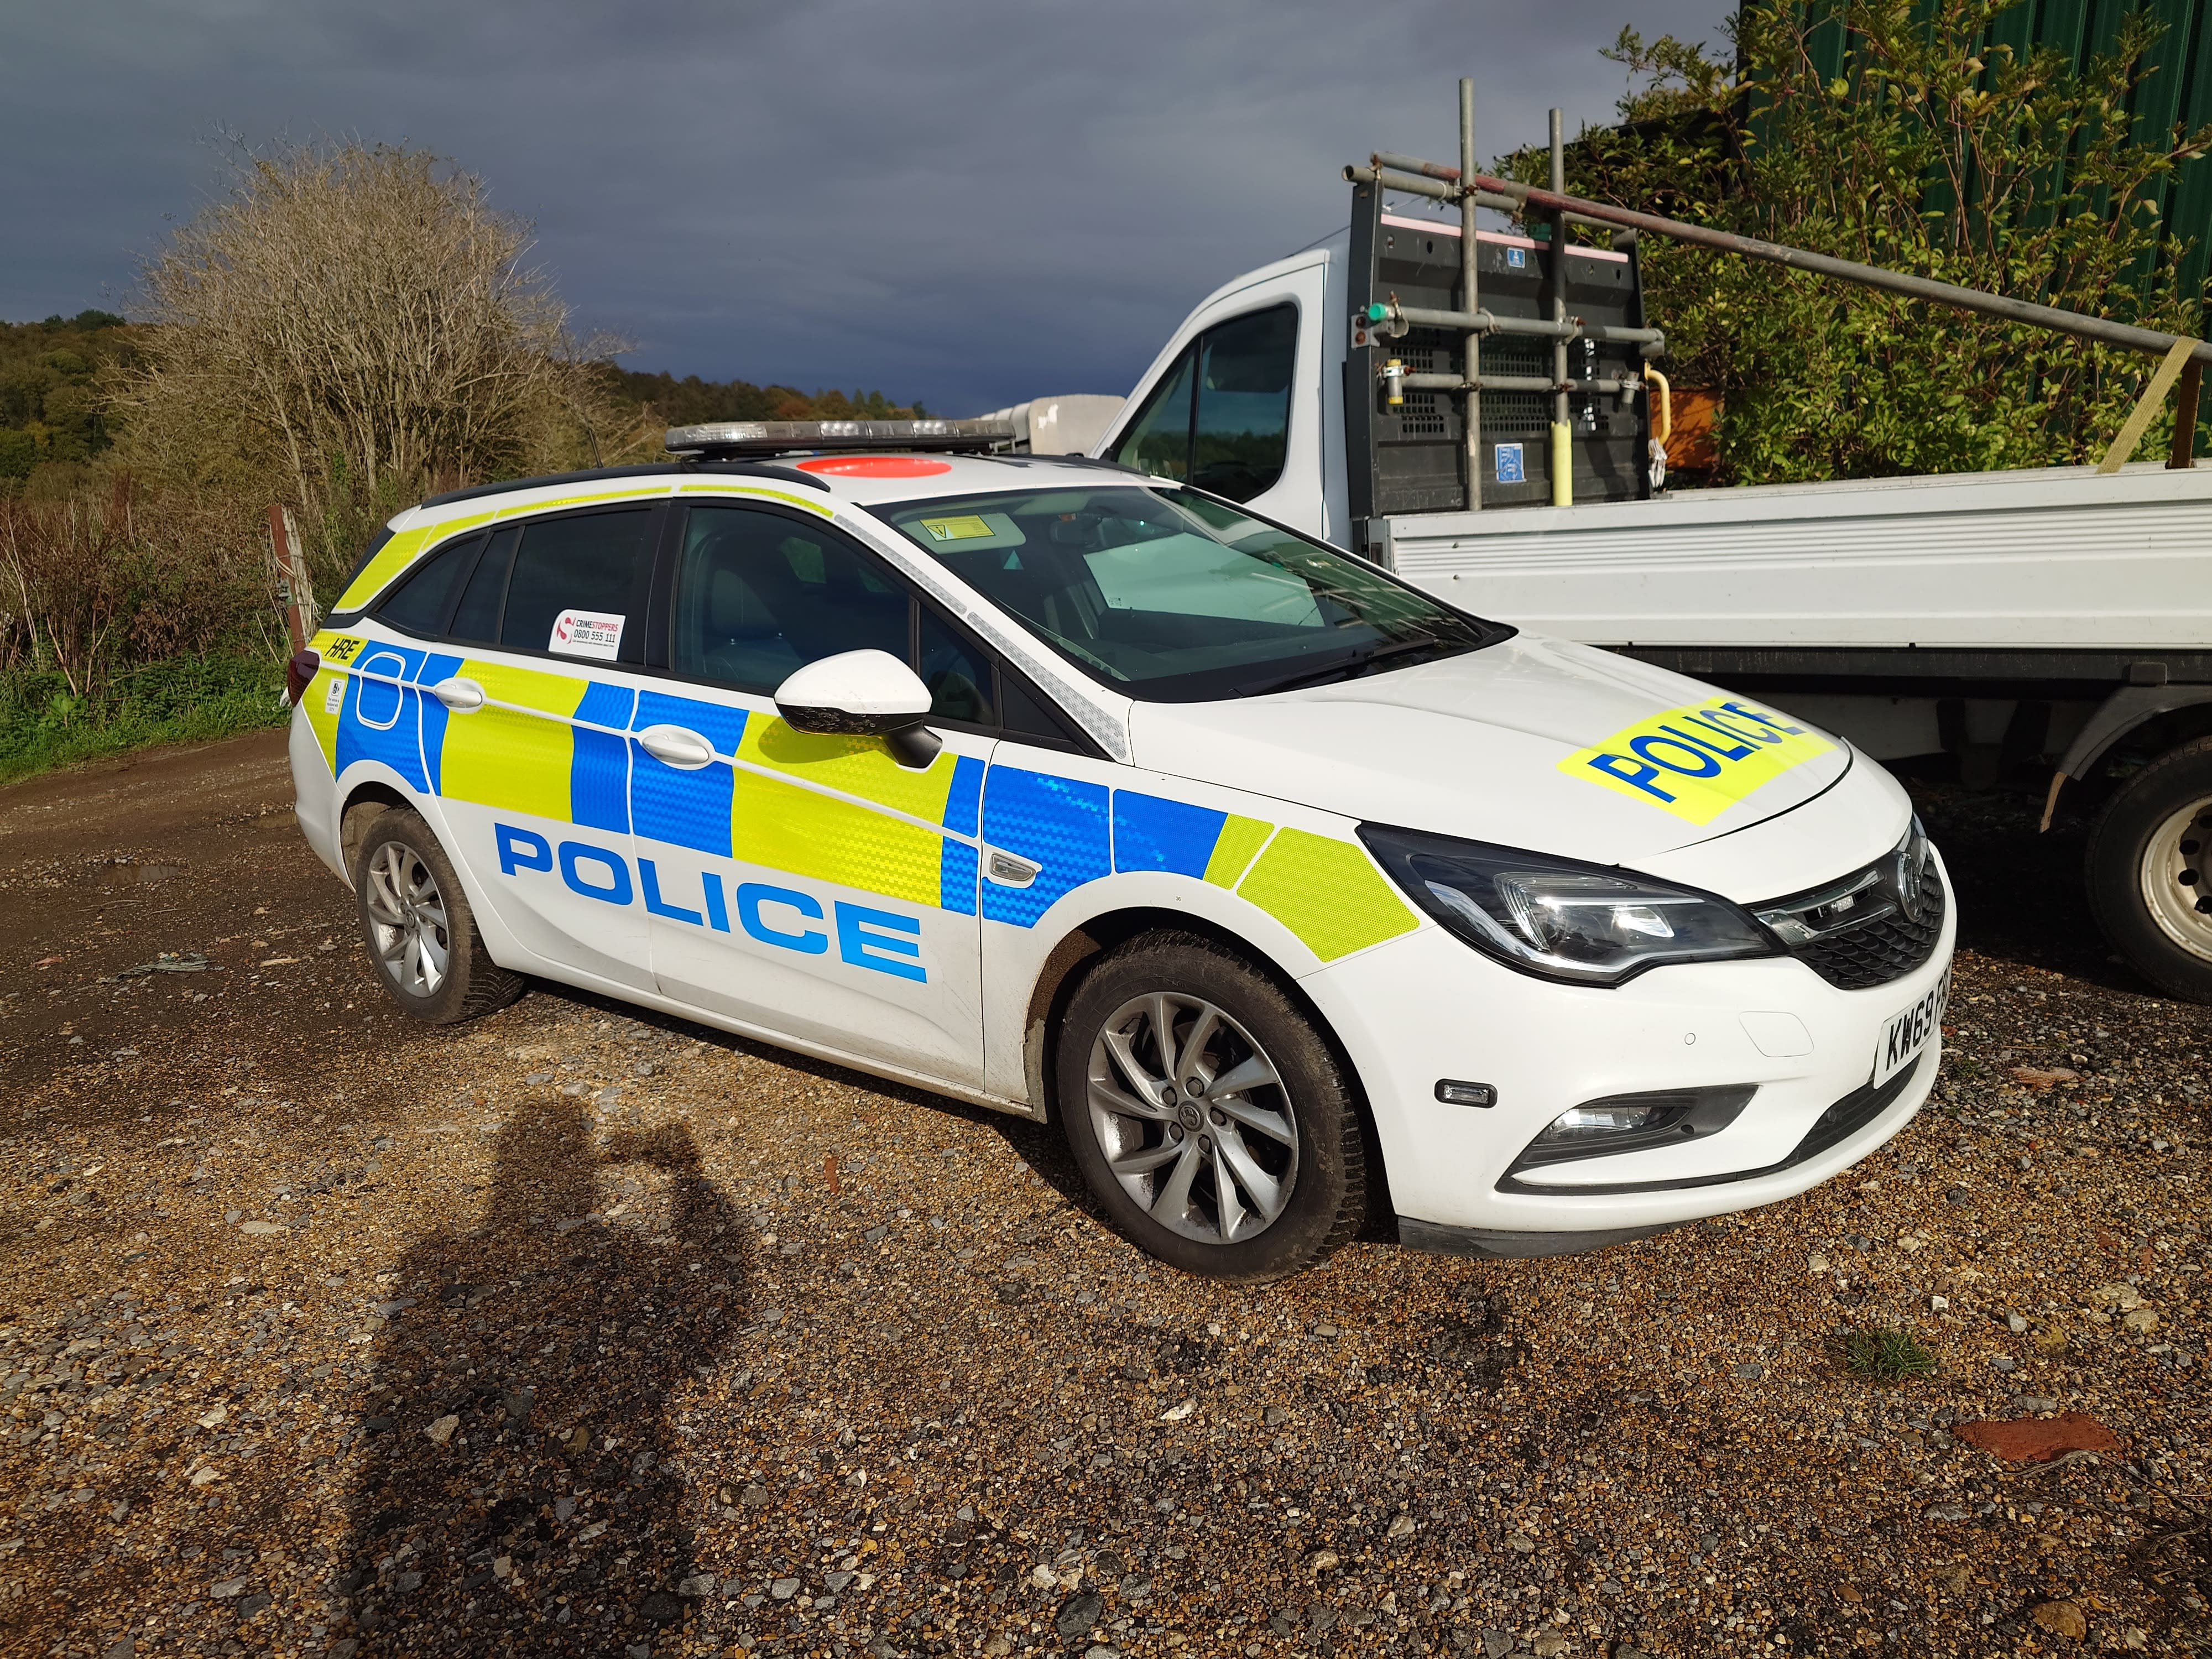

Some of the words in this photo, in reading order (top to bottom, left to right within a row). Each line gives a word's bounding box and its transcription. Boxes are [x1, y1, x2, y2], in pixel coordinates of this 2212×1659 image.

[325, 638, 360, 660] HRE
[574, 629, 589, 639] 0800
[591, 632, 603, 641] 555
[605, 633, 615, 643] 111
[576, 619, 618, 632] CRIMESTOPPERS
[1587, 701, 1807, 803] POLICE
[494, 822, 927, 984] POLICE
[1886, 990, 1934, 1071] KW69
